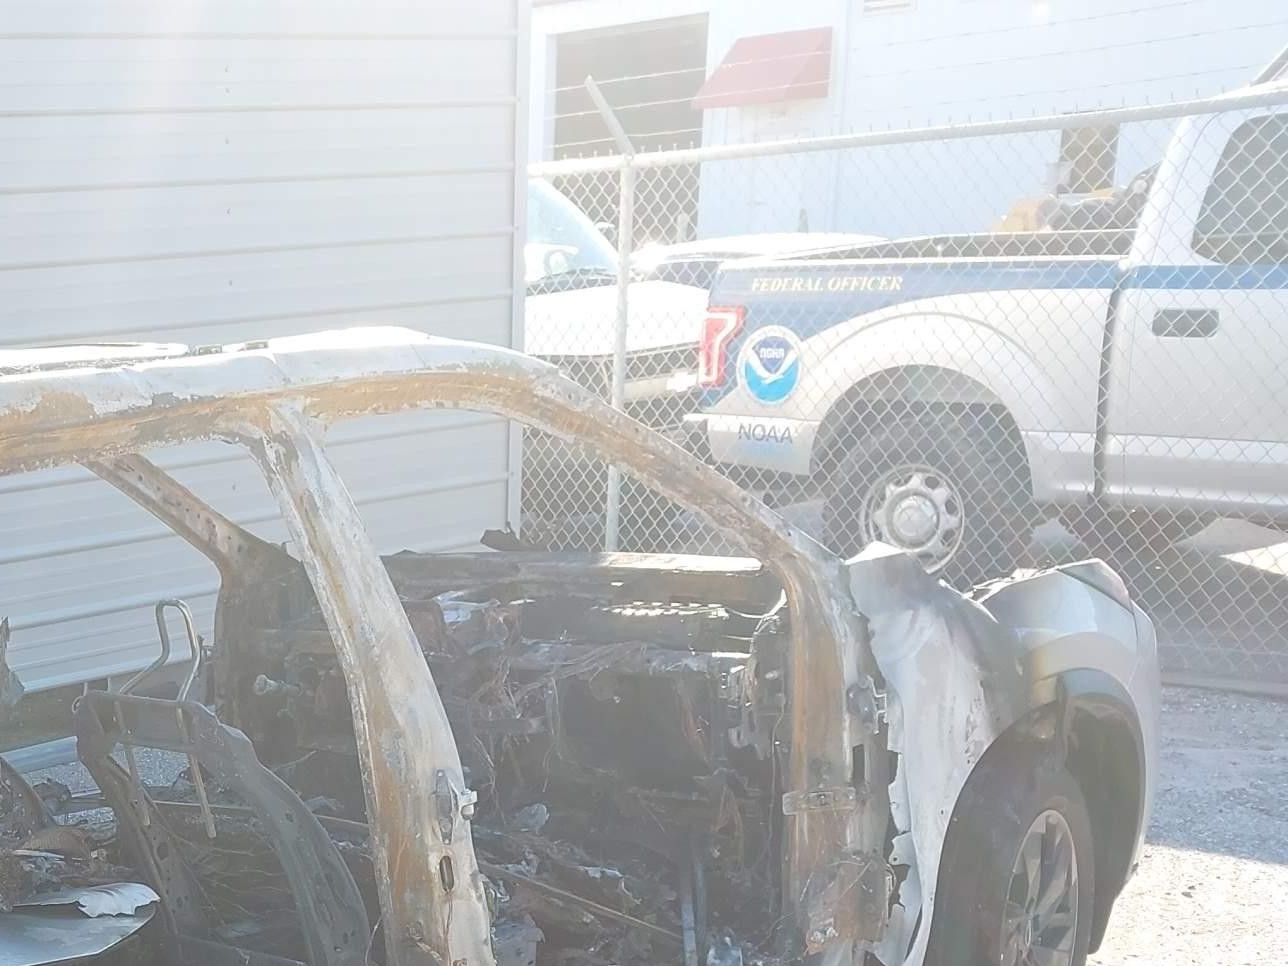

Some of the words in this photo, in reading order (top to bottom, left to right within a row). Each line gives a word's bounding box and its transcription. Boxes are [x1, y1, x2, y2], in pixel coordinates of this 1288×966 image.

[752, 277, 824, 292] FEDERAL
[828, 275, 904, 291] OFFICER
[738, 424, 793, 444] NOAA
